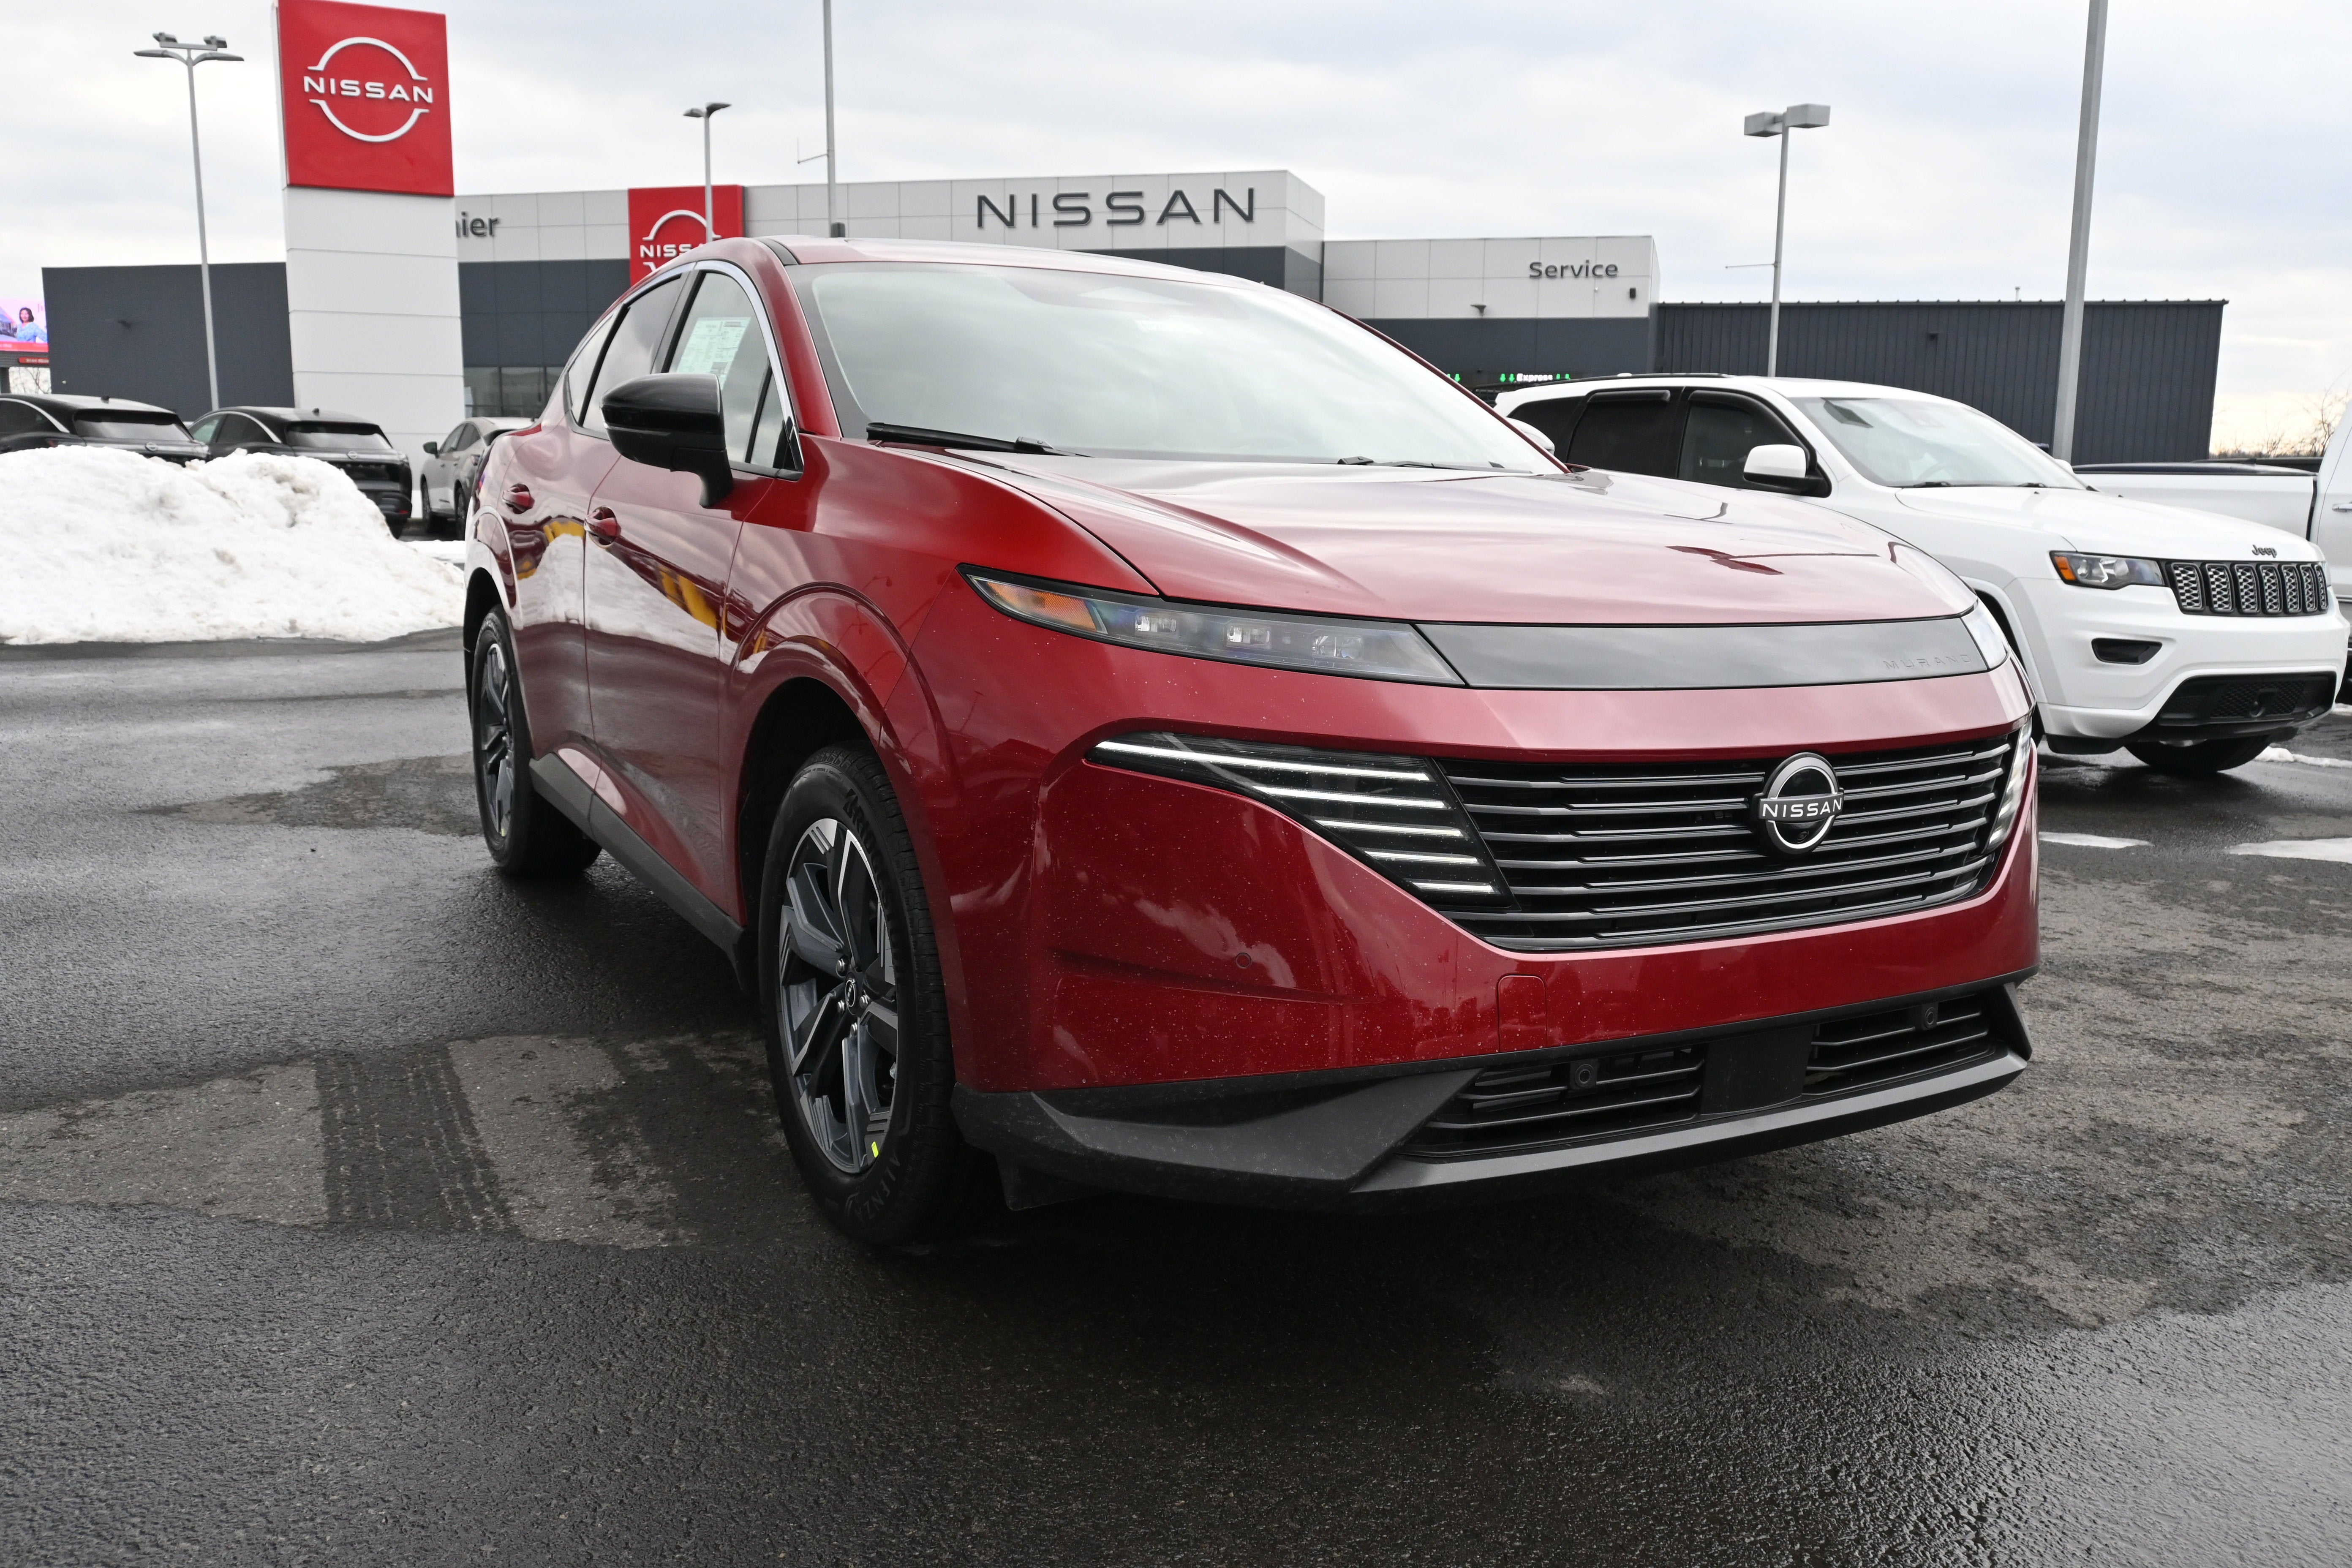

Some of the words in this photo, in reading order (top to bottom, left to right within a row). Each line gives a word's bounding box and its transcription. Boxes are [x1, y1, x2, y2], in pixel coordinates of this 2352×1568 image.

[303, 76, 433, 103] NISSAN
[977, 187, 1254, 228] NISSAN
[640, 243, 706, 259] NISS
[1529, 260, 1618, 279] Service
[1516, 373, 1553, 383] Express
[2251, 544, 2277, 558] Jeep
[1883, 654, 1972, 670] MURANO
[1762, 797, 1842, 817] NISSAN
